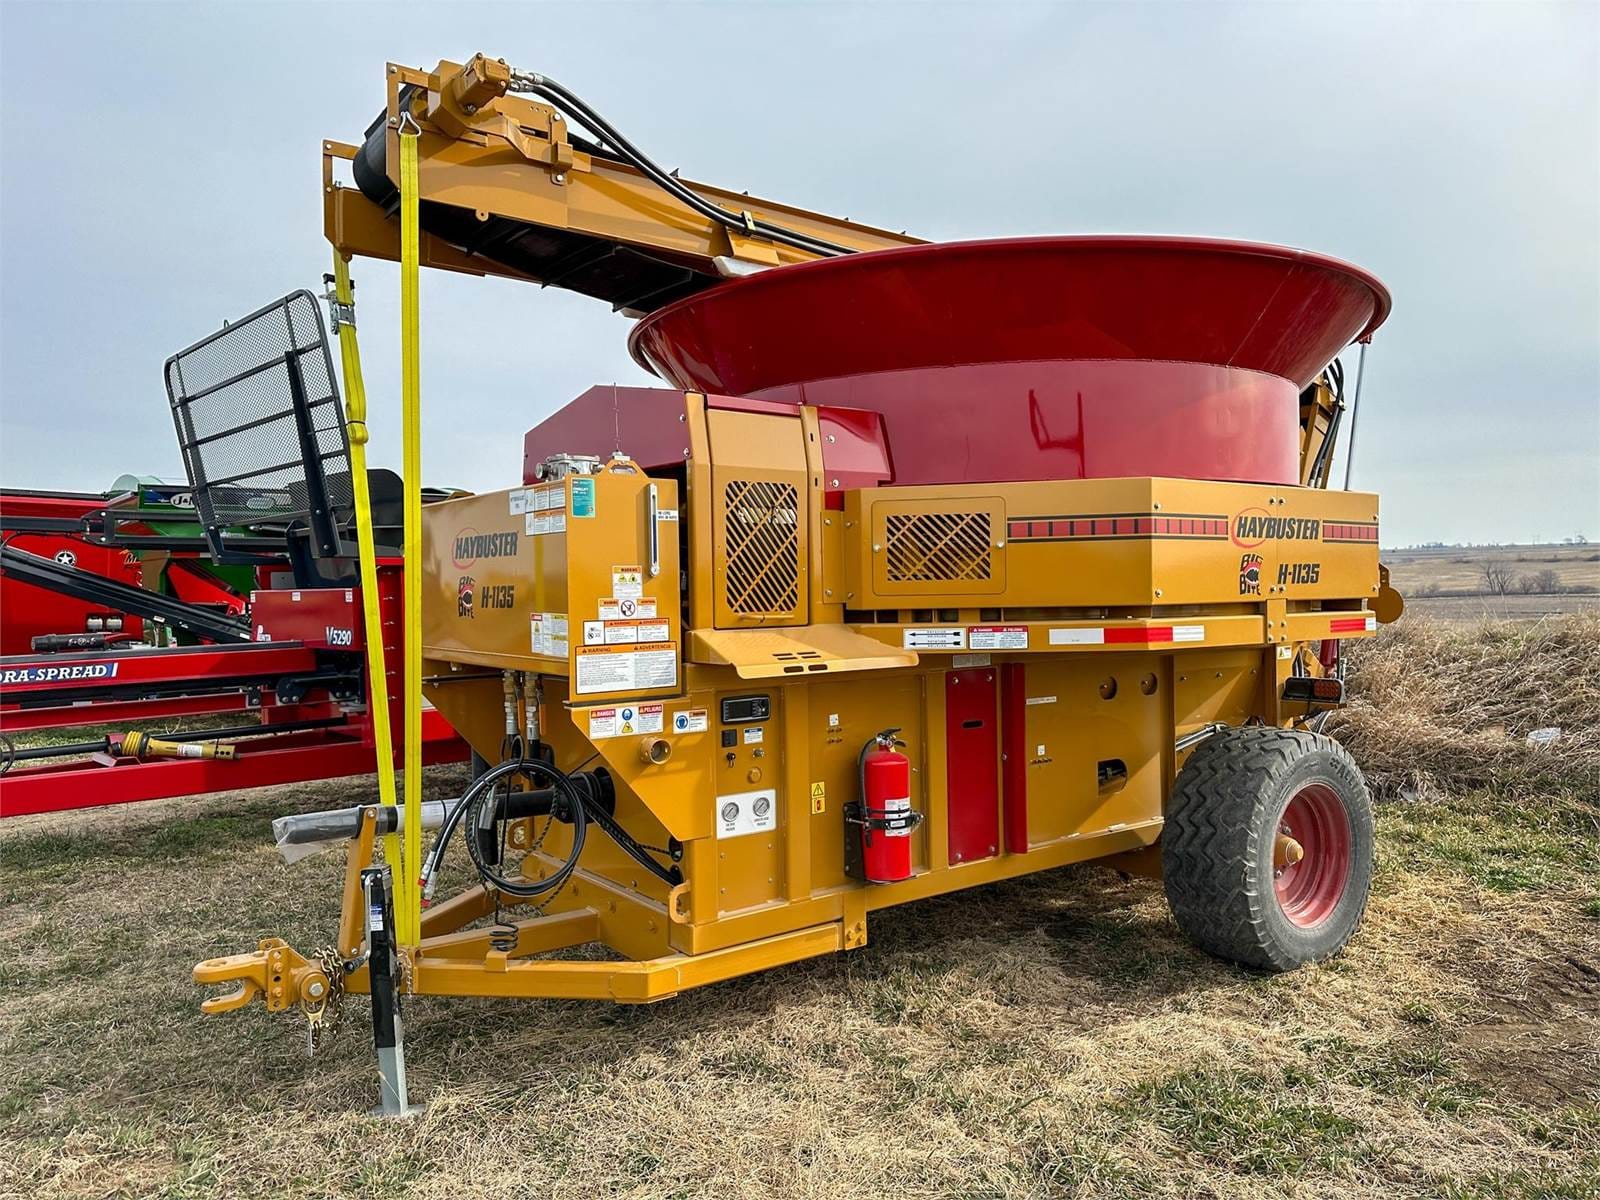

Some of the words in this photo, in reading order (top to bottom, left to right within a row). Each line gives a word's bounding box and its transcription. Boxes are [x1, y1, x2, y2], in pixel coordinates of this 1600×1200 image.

[173, 495, 194, 506] J&
[1236, 516, 1320, 539] HAYBUSTER
[455, 532, 518, 560] HAYBUSTER
[1240, 553, 1264, 572] BIG
[1278, 564, 1320, 584] H-1135
[1239, 574, 1261, 596] BITE
[481, 585, 515, 609] H-1135
[325, 626, 352, 646] V5290
[0, 664, 107, 684] RA-SPREAD
